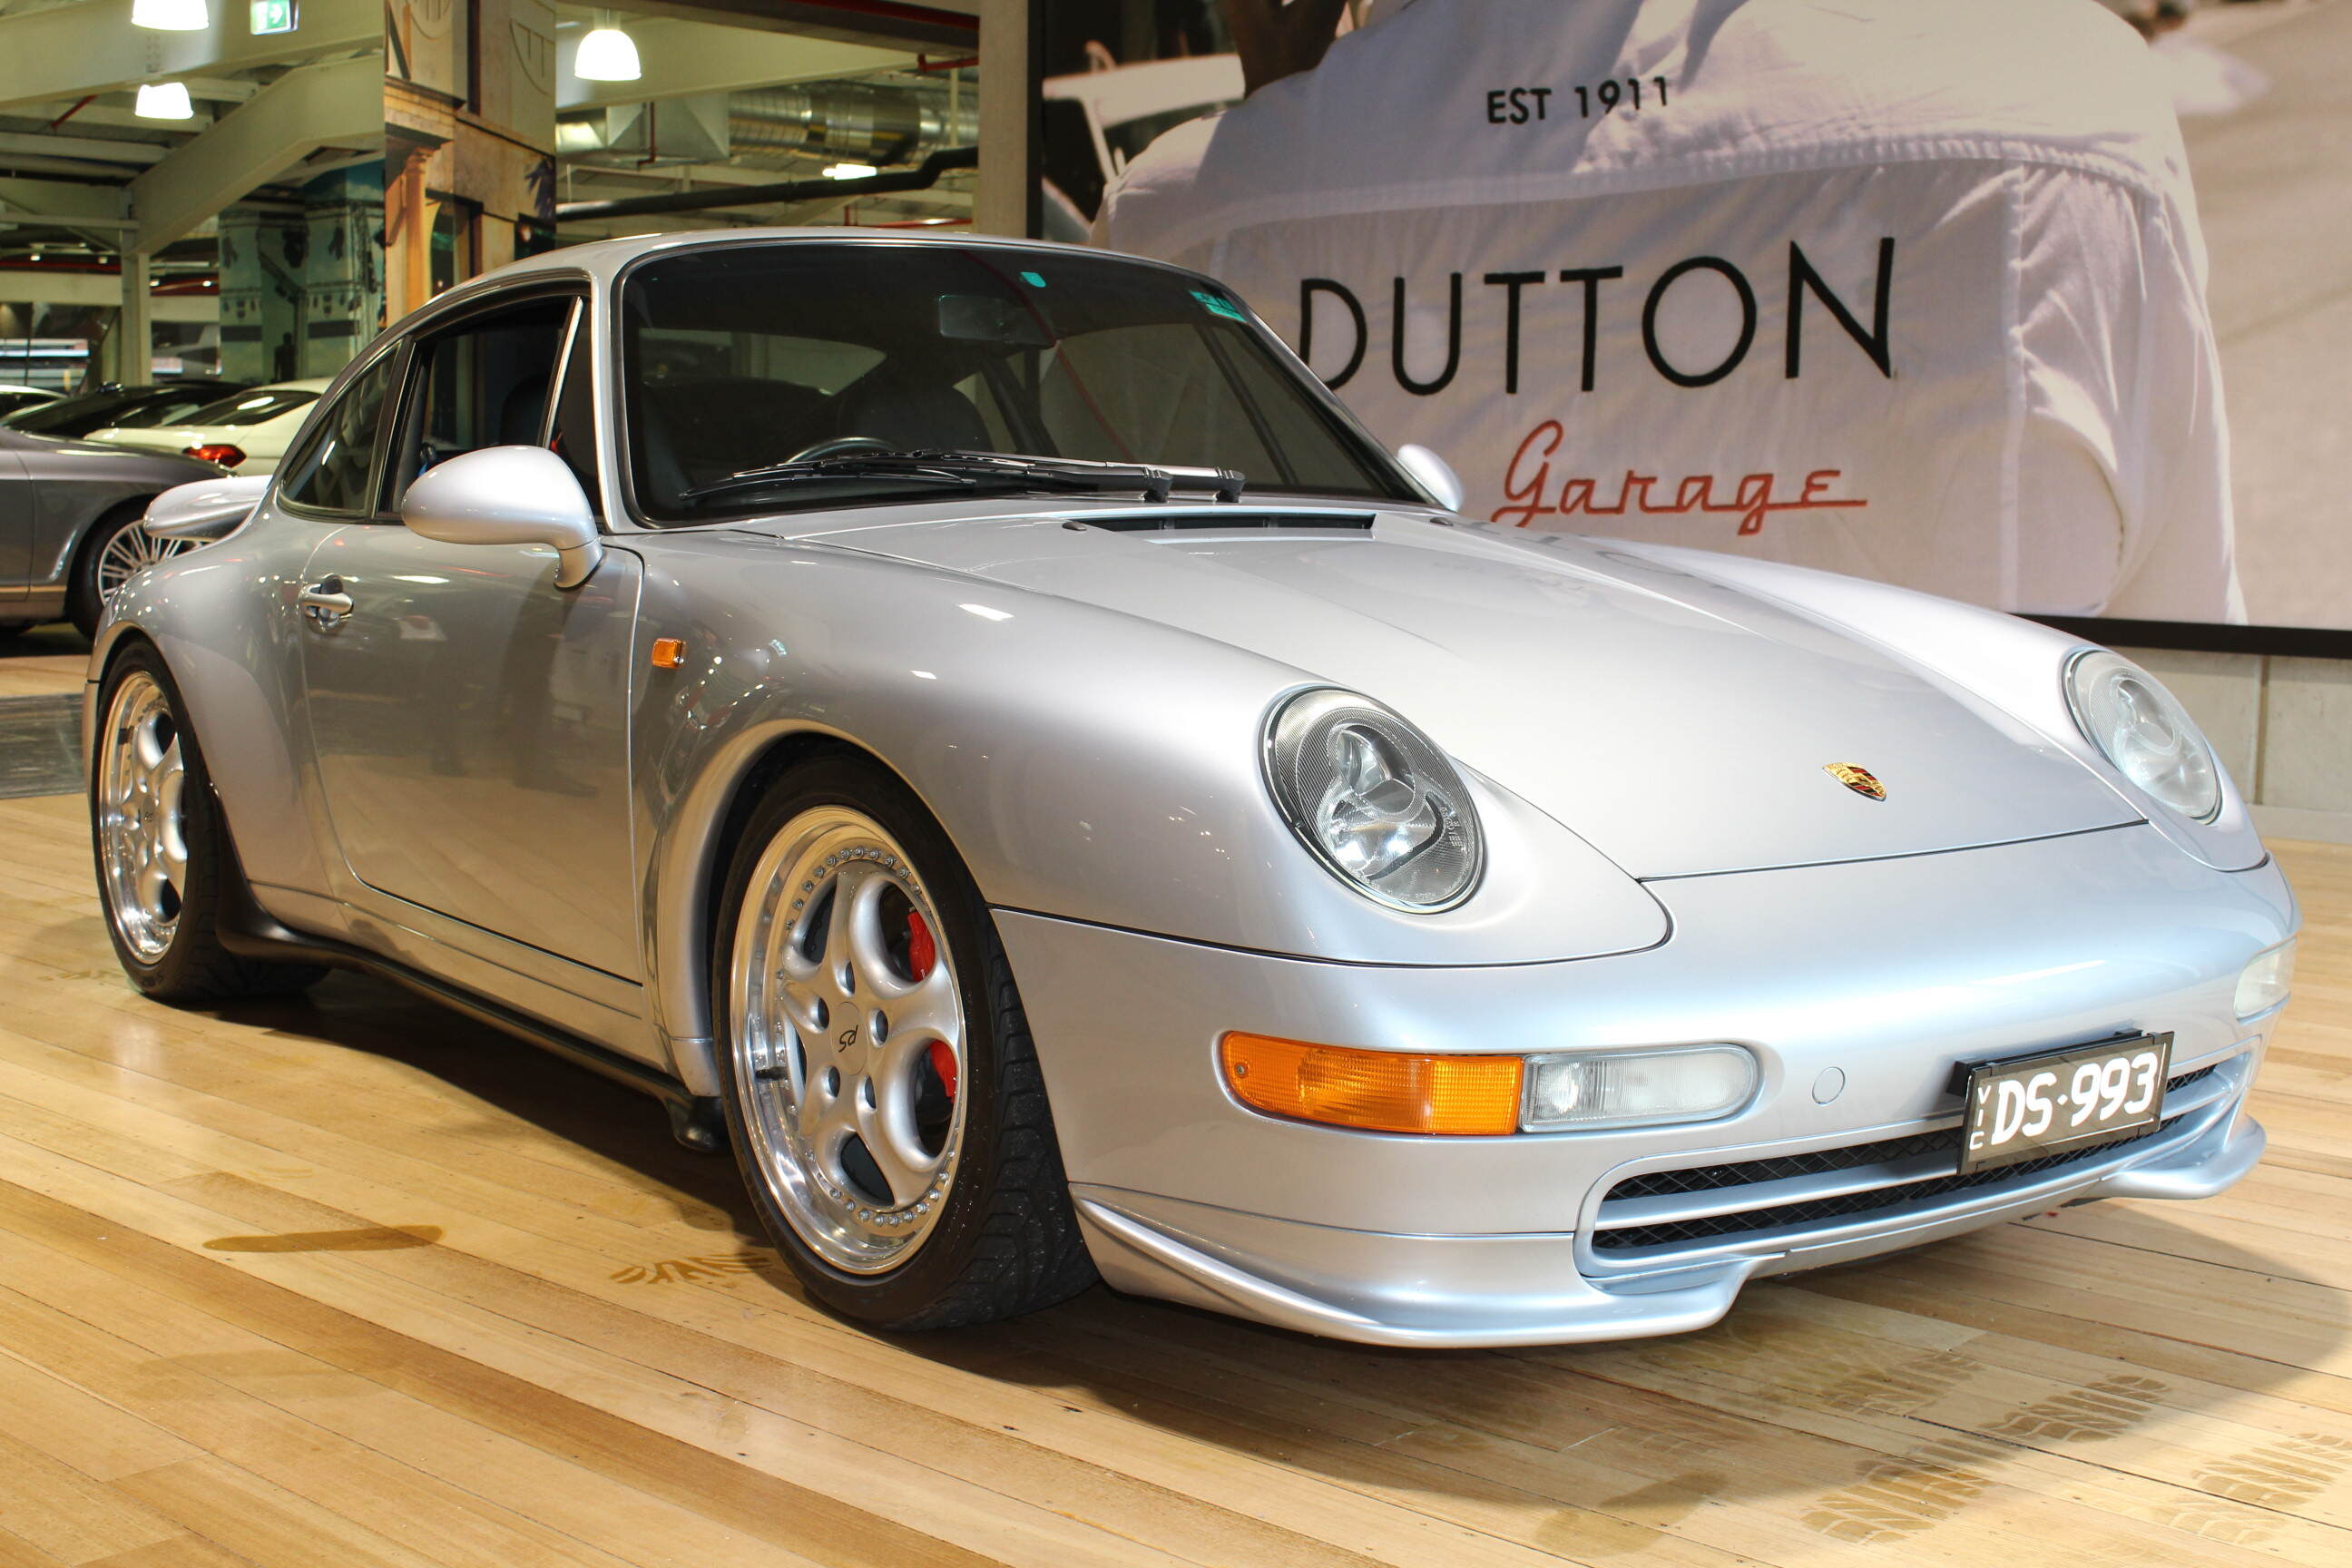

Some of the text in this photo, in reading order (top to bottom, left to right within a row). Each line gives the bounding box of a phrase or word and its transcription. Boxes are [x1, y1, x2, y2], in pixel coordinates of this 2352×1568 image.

[1487, 76, 1667, 124] EST 1911
[1299, 237, 1895, 396] DUTTON
[1492, 419, 1867, 535] Garage
